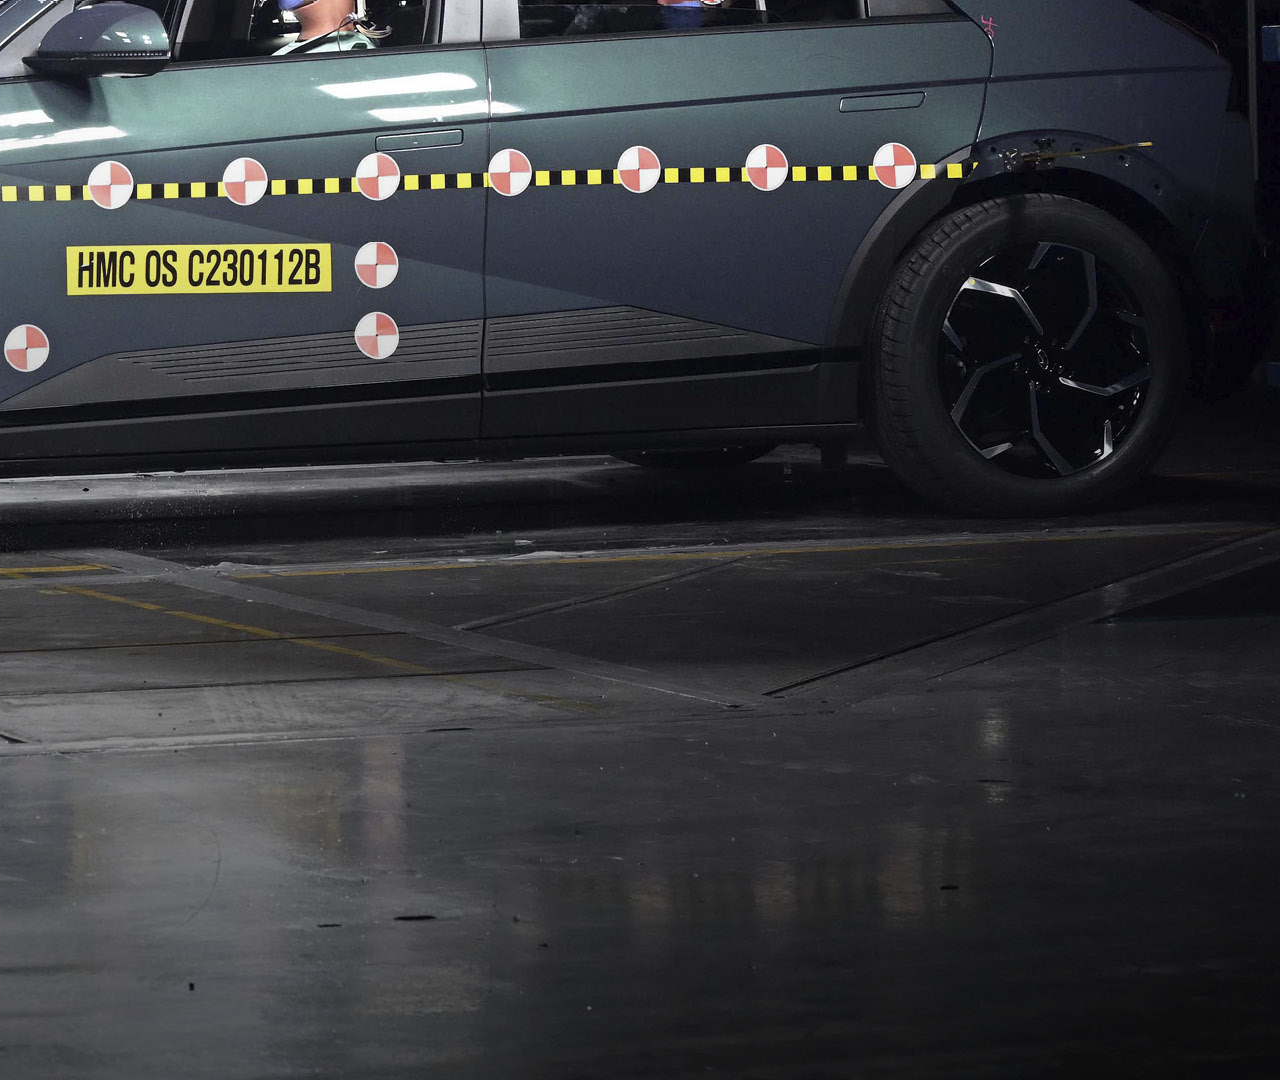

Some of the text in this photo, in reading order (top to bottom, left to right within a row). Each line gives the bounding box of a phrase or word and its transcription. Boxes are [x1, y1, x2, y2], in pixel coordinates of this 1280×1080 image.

[77, 248, 321, 288] HMC OS C230112B
